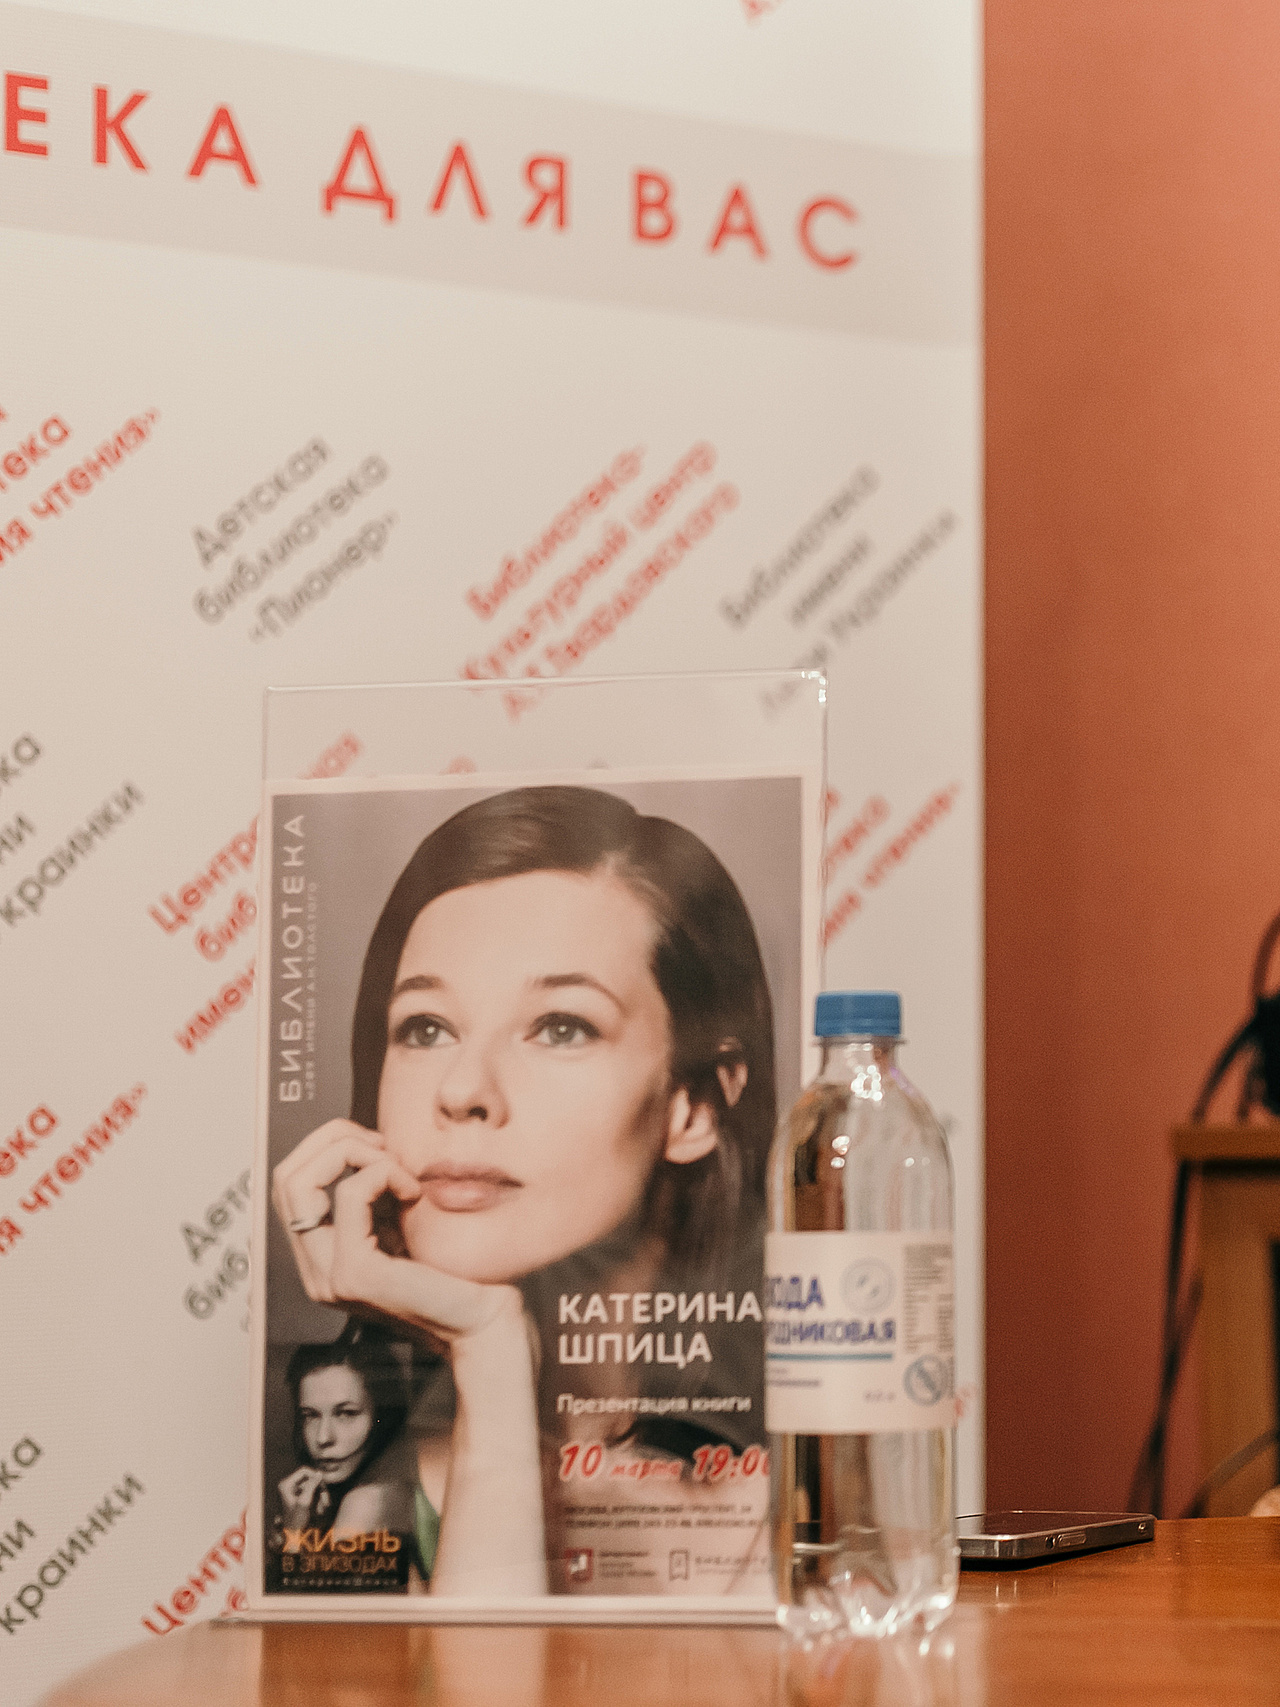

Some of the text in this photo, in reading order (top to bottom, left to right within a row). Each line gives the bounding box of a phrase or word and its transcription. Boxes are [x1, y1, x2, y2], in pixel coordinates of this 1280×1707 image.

[322, 125, 575, 230] ДЛЯ
[632, 170, 860, 272] ВАС
[193, 437, 330, 570] Детская
[194, 454, 390, 625] библиотека
[278, 814, 305, 1103] БИБЛИОТЕКА
[558, 1291, 763, 1325] КАТЕРИНА
[558, 1332, 713, 1369] ШПИЦА
[556, 1392, 752, 1416] Презентация книги
[560, 1442, 603, 1481] 10
[282, 1528, 401, 1554] ЖИЗНЬ
[282, 1555, 294, 1574] В
